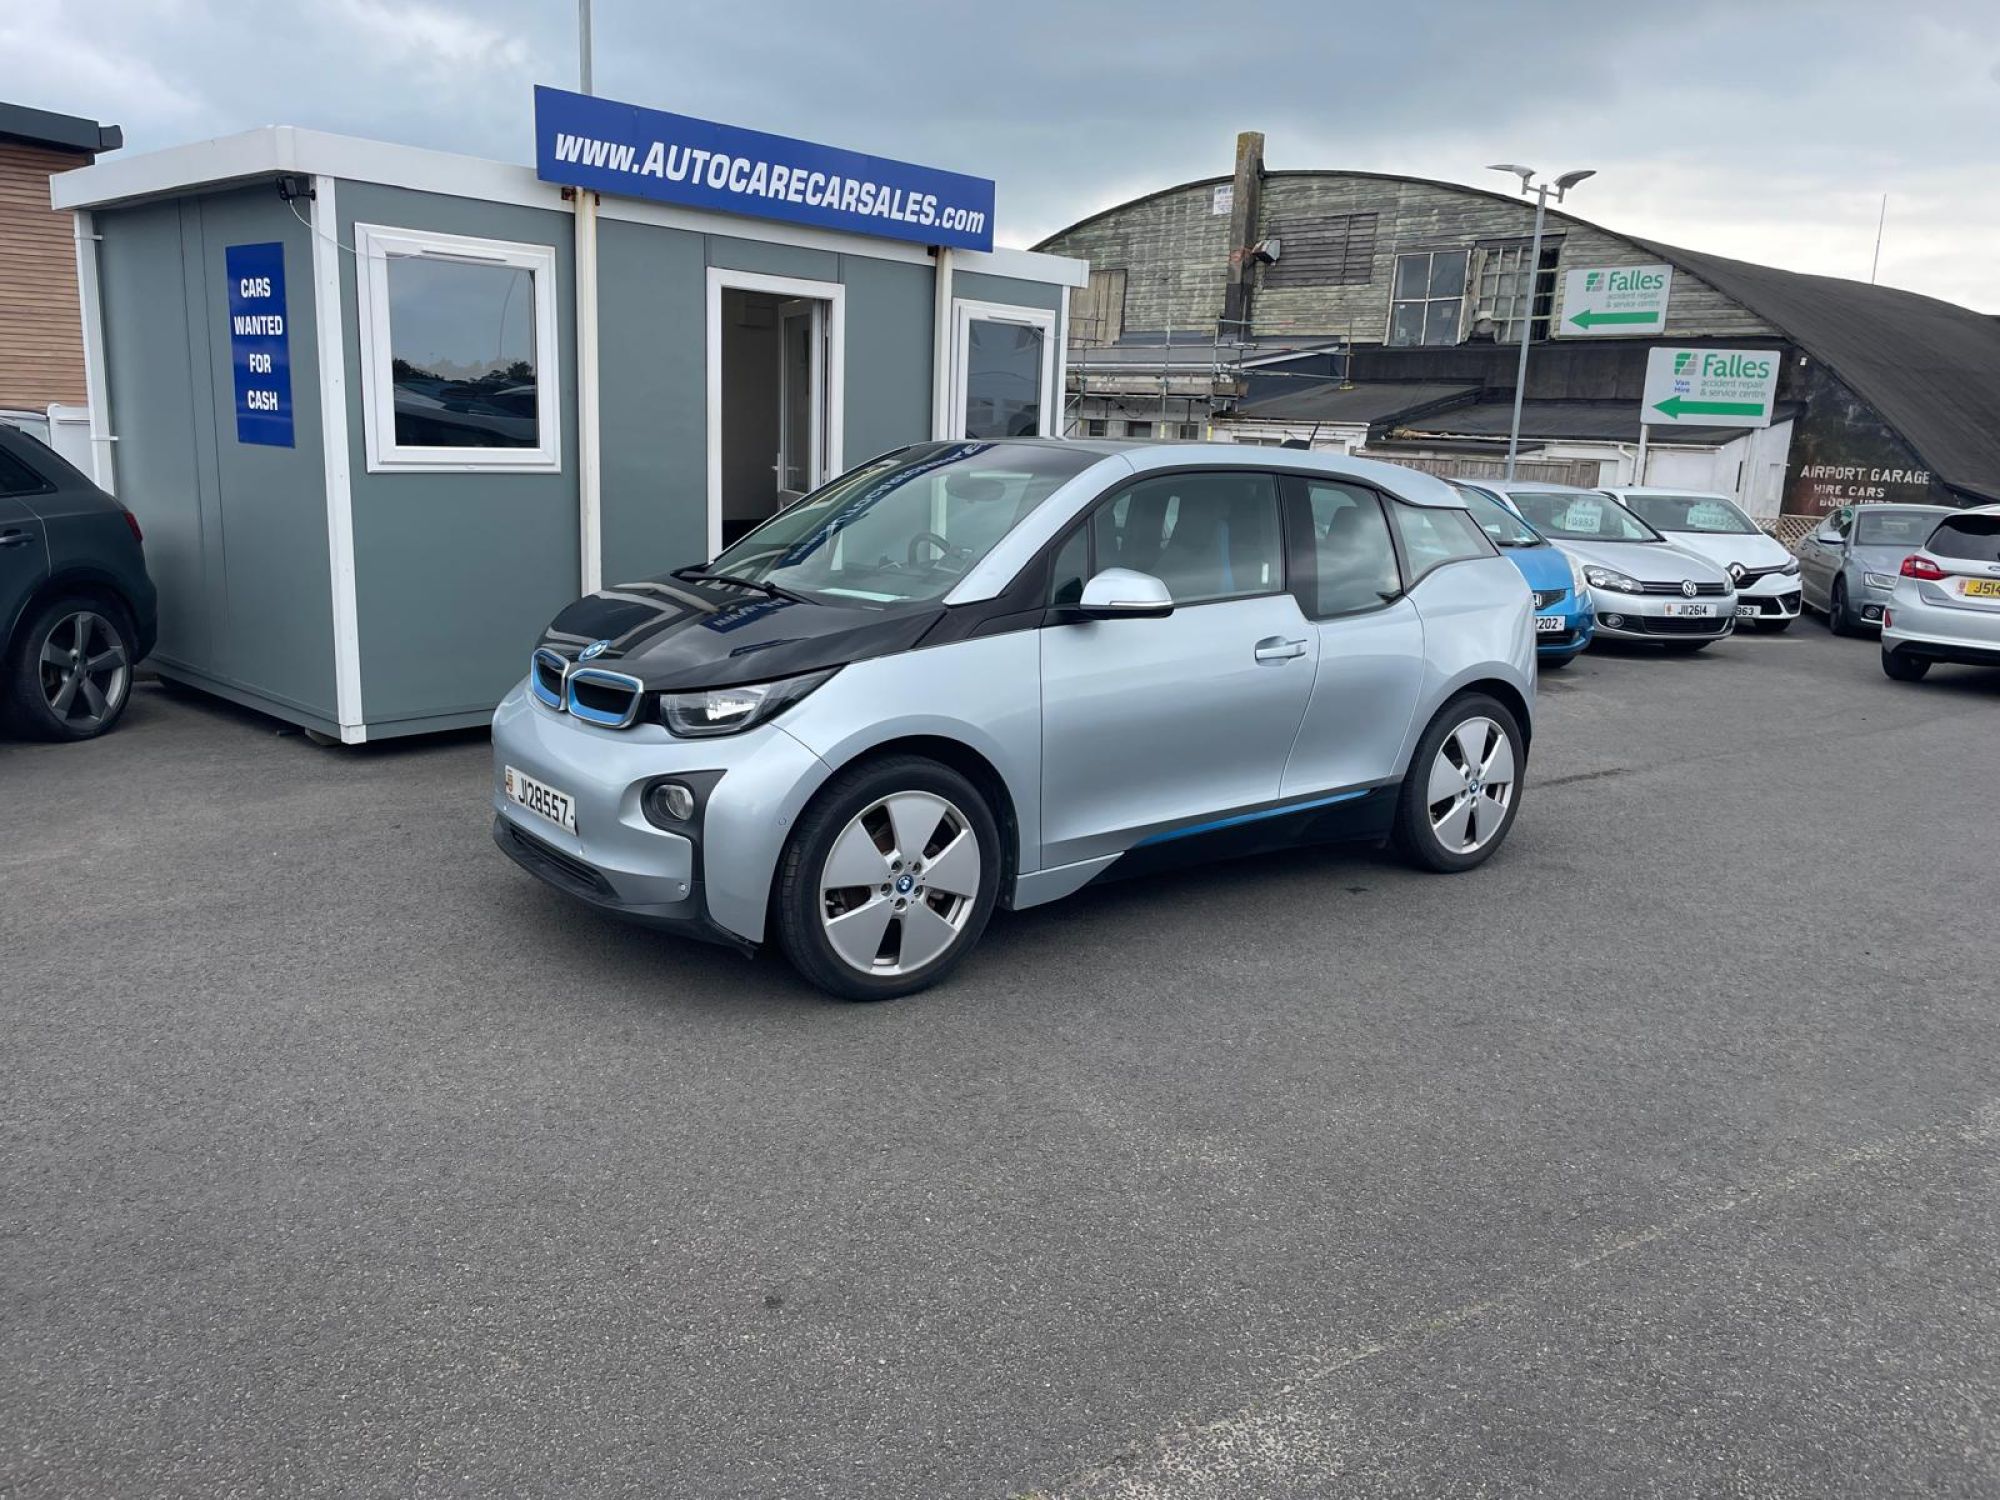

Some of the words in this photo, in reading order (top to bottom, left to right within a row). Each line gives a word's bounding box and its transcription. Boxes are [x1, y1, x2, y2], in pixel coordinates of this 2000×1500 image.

[555, 132, 985, 234] www.AUTOCARECARSALES.com
[240, 277, 271, 299] CARS
[1608, 269, 1664, 292] Falles
[234, 315, 283, 336] WANTED
[249, 353, 272, 374] FOR
[1702, 353, 1770, 379] Falles
[1709, 389, 1738, 397] service
[1739, 390, 1766, 398] centre
[1738, 380, 1764, 390] repair
[247, 389, 279, 411] CASH
[1800, 465, 1866, 481] AIRPORT
[1871, 468, 1930, 485] GARAGE
[1814, 484, 1842, 495] HIRE
[1848, 486, 1885, 497] CARS
[518, 777, 568, 826] J128557
